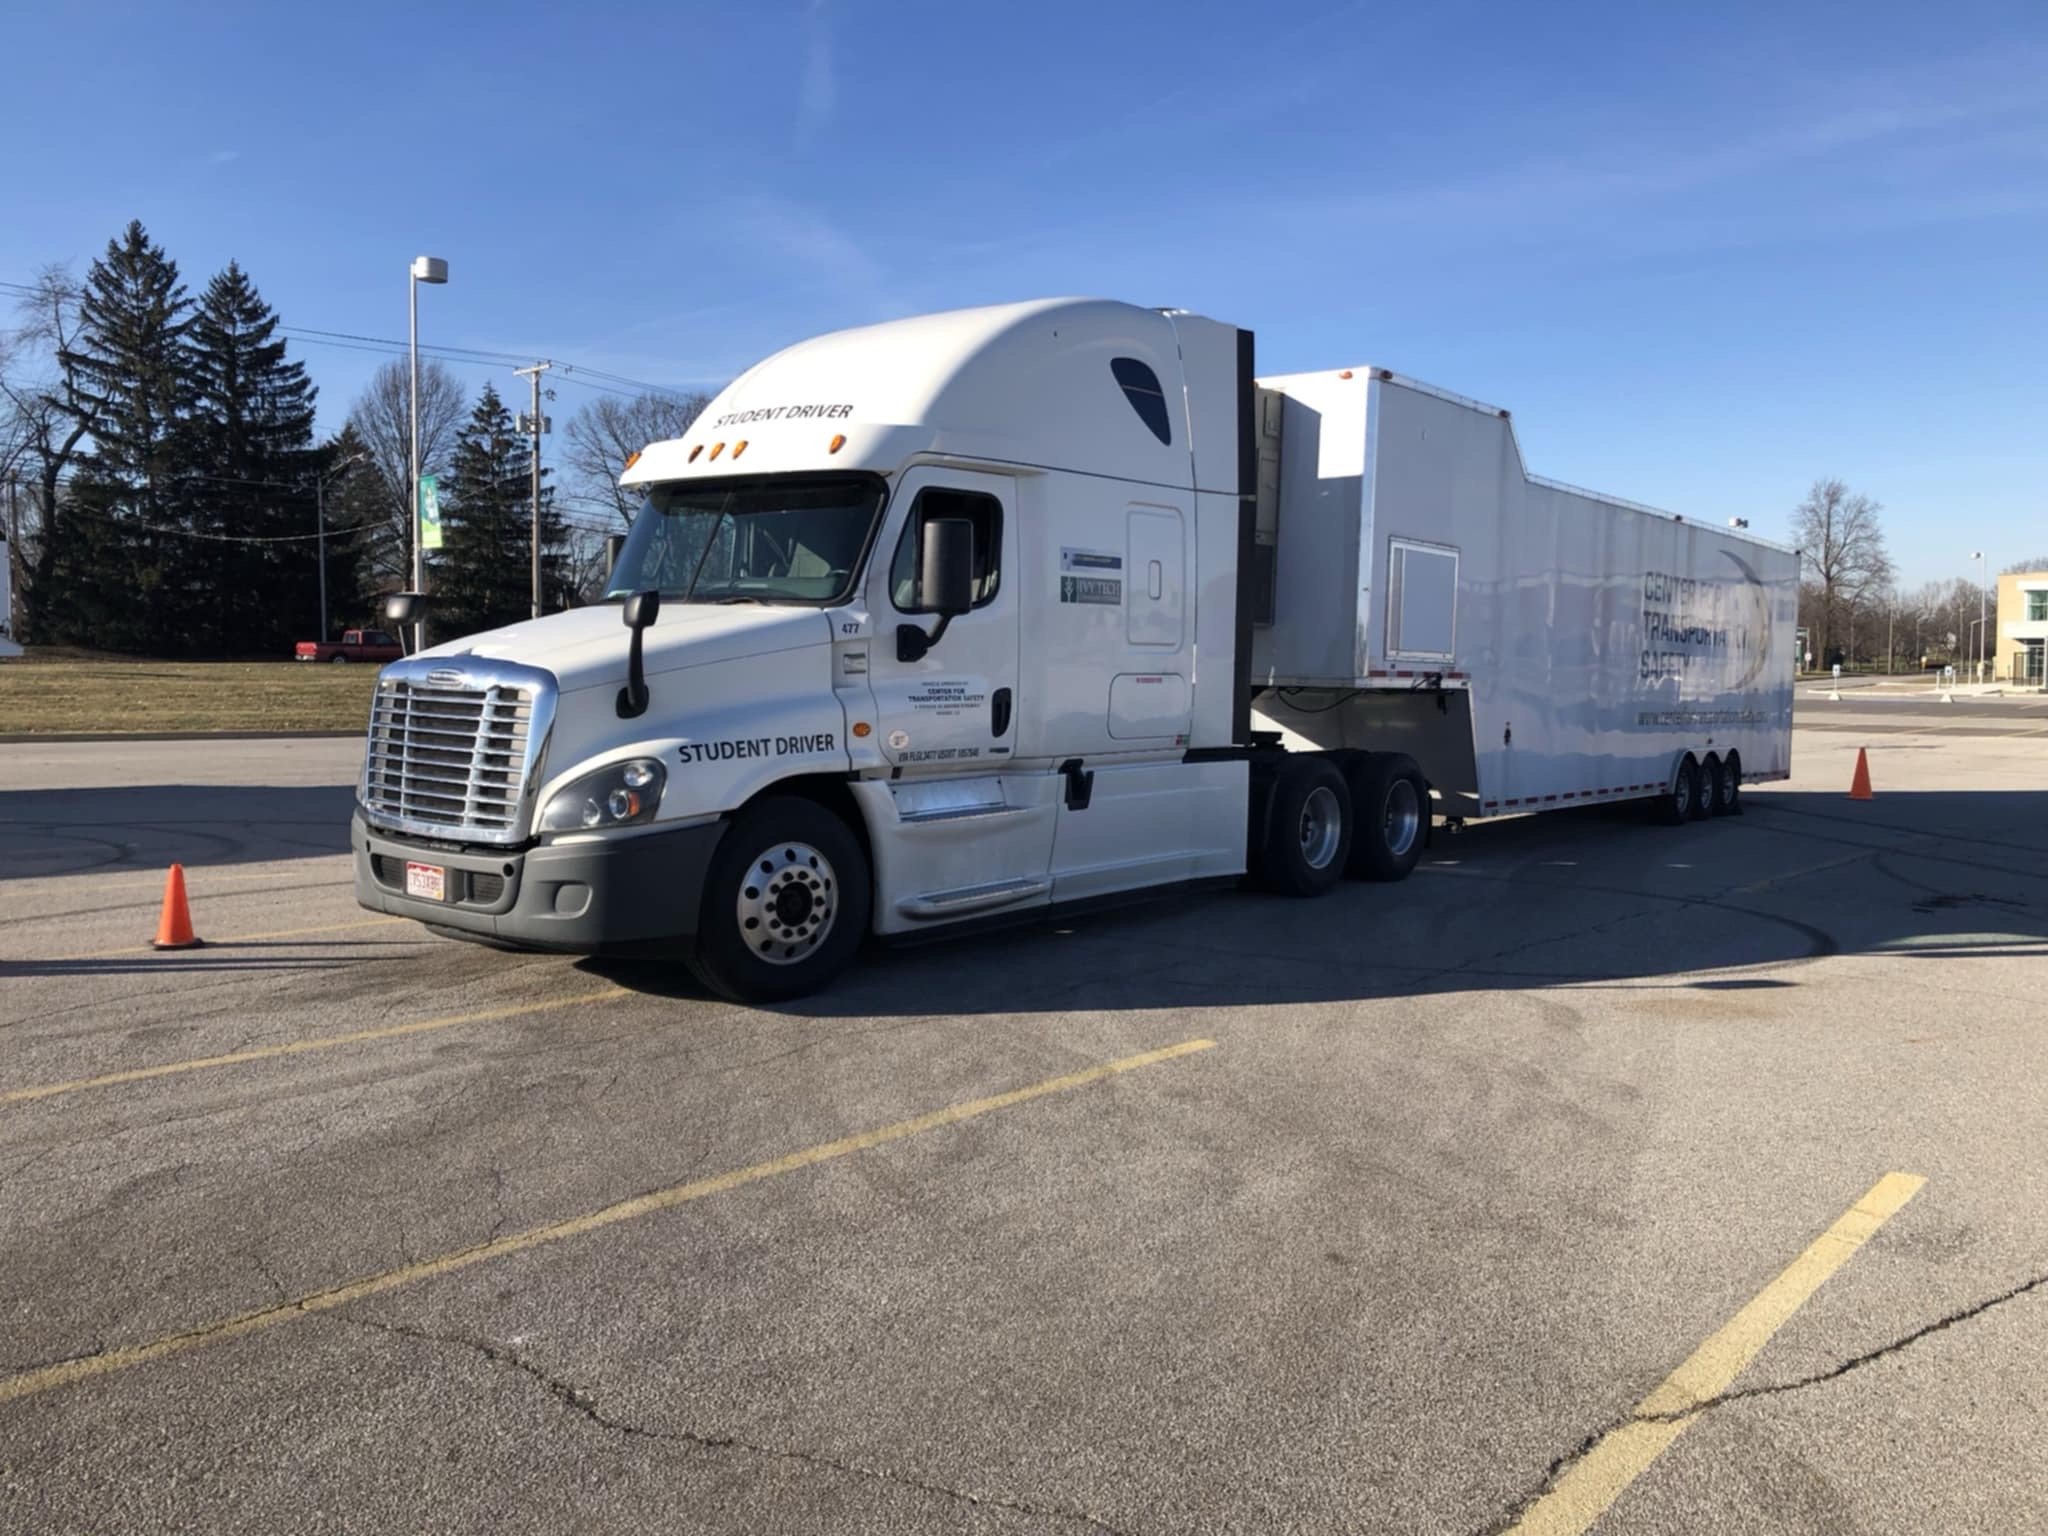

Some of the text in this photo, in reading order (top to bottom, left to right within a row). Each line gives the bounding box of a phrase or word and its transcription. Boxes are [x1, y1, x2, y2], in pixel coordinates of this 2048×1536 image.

[713, 404, 854, 429] STUDENT DRIVER
[841, 623, 859, 633] 477
[1640, 648, 1691, 679] SAFETY
[678, 734, 835, 763] STUDENT DRIVER
